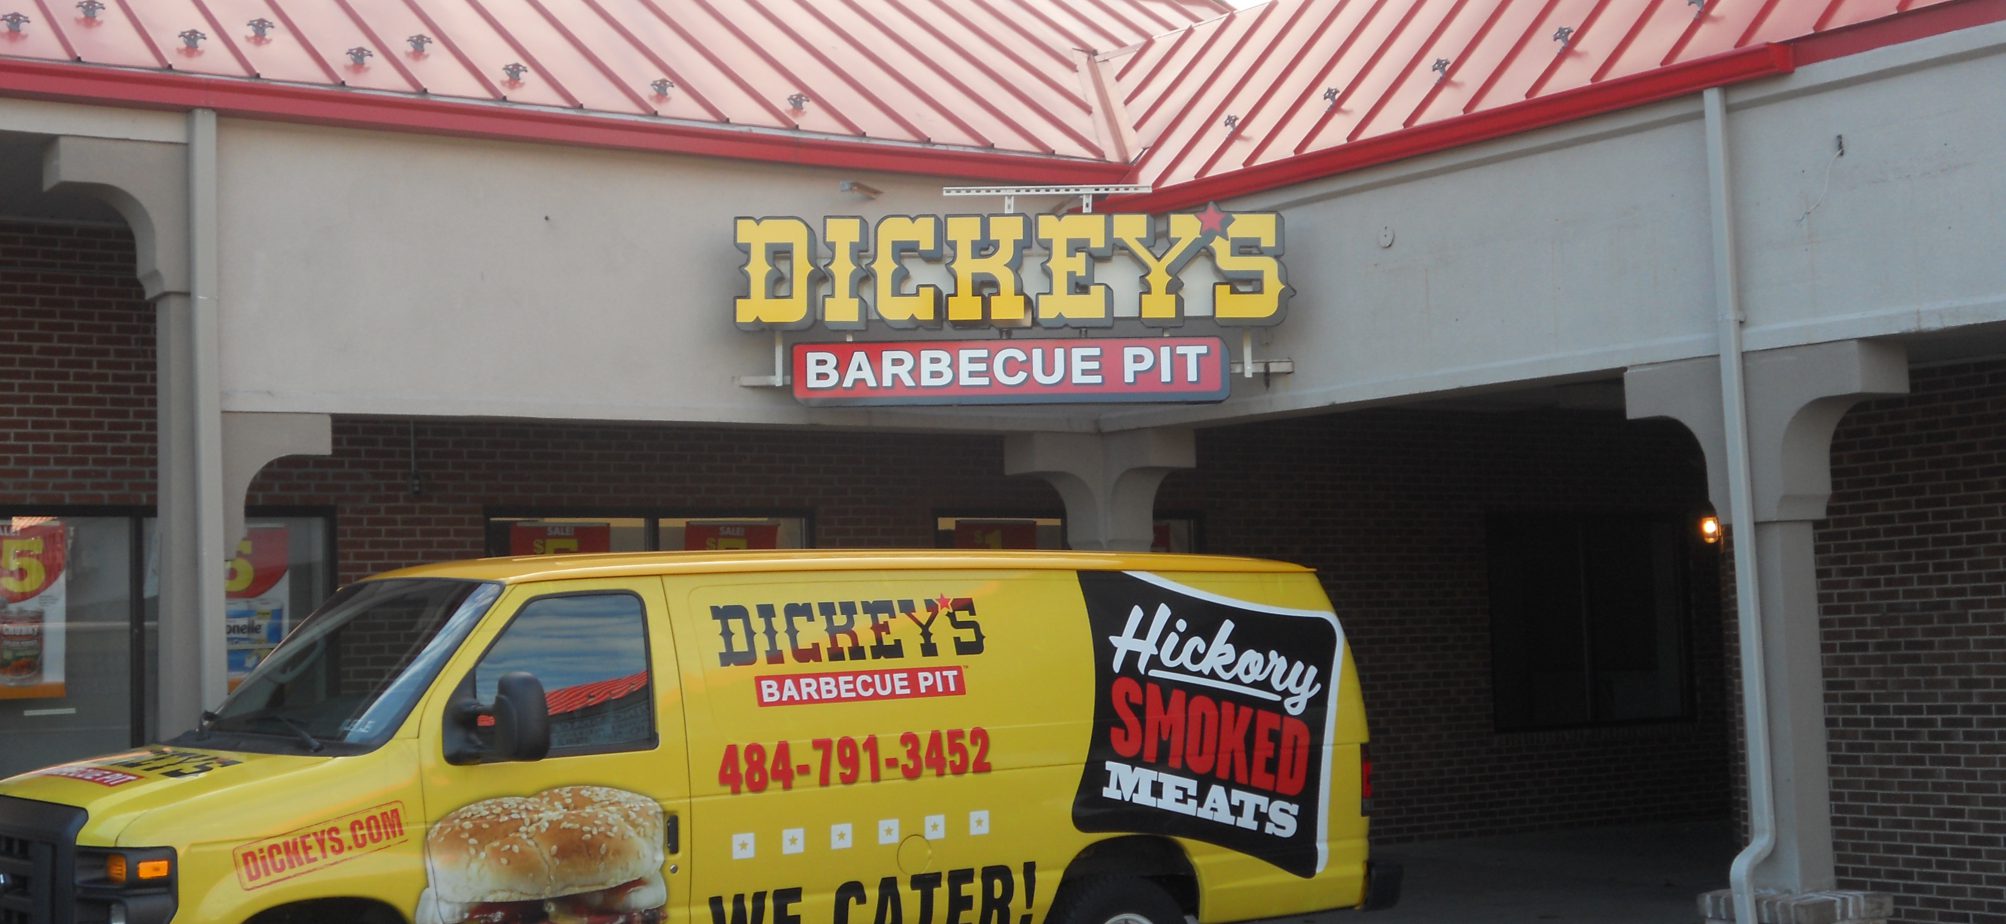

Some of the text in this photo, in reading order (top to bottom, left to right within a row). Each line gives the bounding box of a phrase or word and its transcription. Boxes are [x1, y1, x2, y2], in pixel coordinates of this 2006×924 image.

[805, 345, 1208, 389] BARBECUE PIT
[546, 526, 575, 536] SALE!
[719, 526, 745, 536] SALE!
[760, 670, 958, 703] BARBECUE PIT
[1108, 602, 1322, 716] Hickory
[718, 726, 993, 795] 484-791-3452
[1110, 676, 1311, 797] SMOKED
[1102, 760, 1299, 838] MEATS
[708, 861, 1036, 924] WE CATER!
